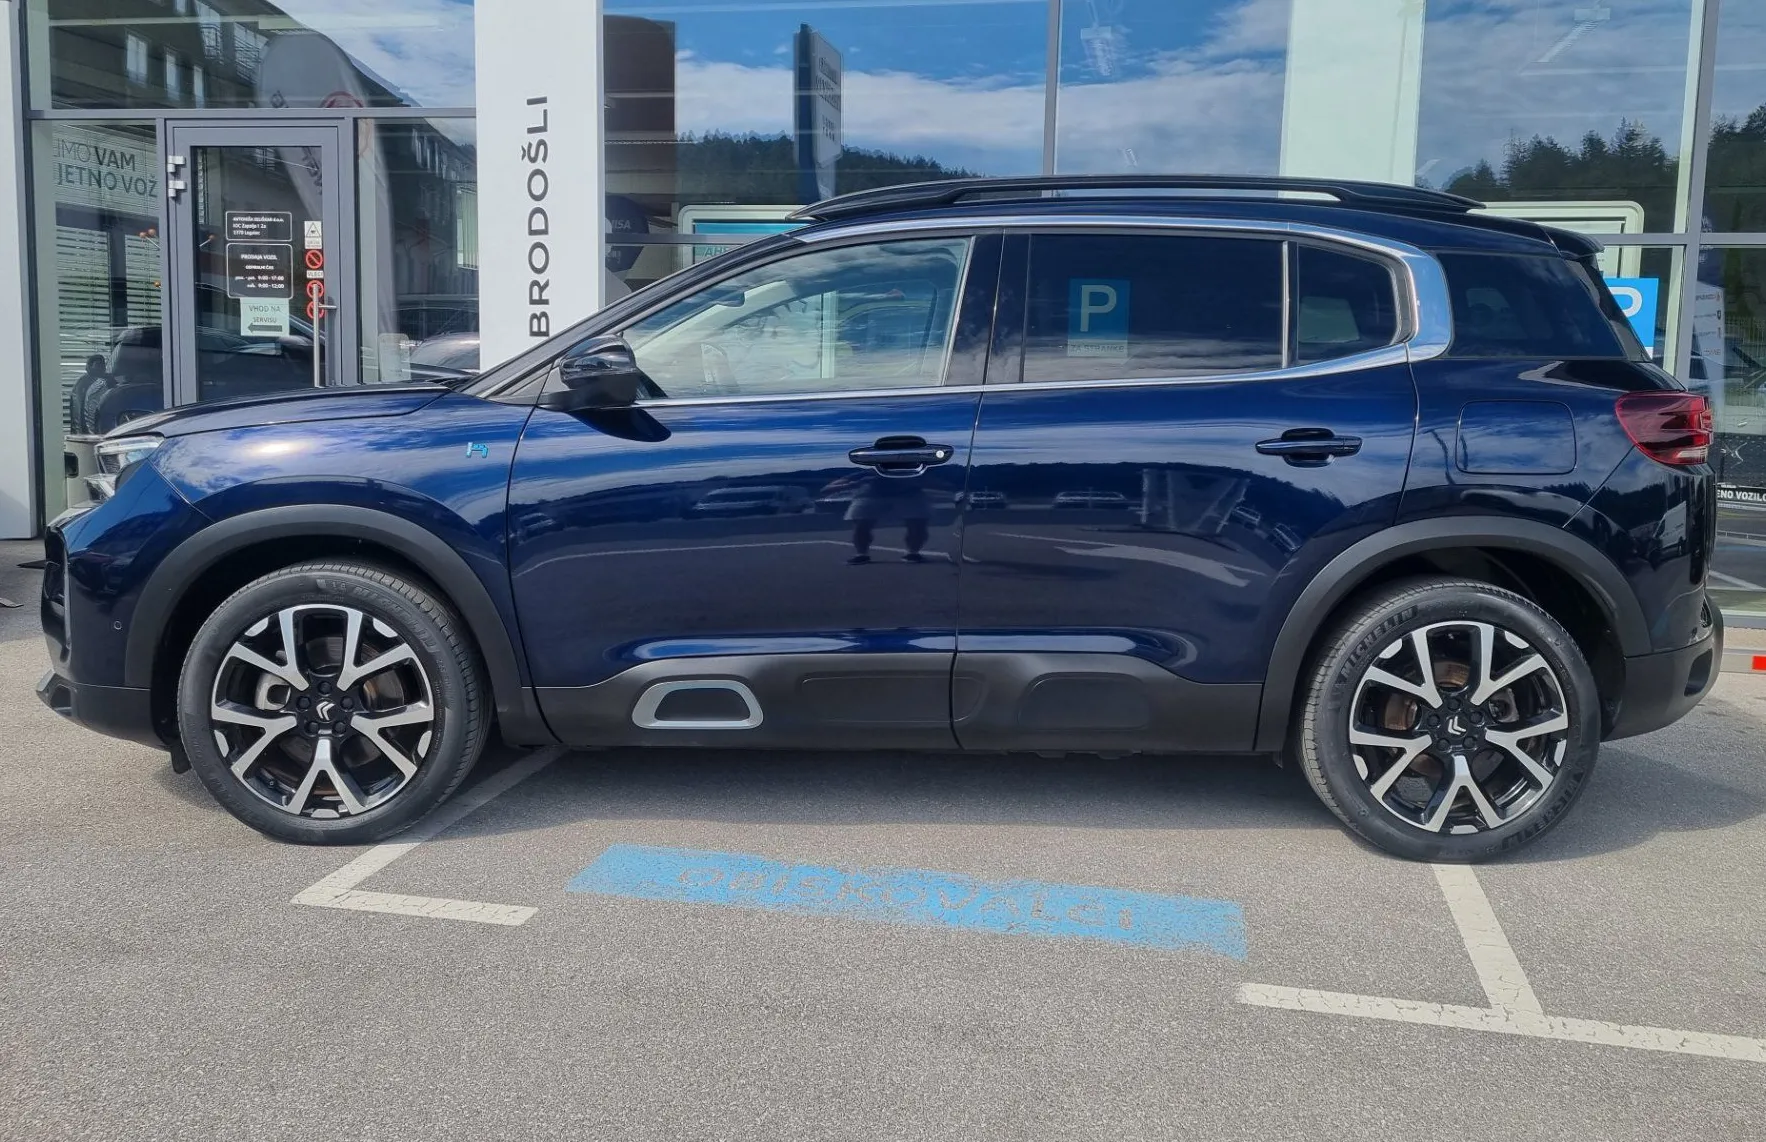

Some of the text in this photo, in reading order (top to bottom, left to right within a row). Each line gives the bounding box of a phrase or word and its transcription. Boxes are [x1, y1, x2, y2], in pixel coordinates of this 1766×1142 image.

[53, 138, 136, 172] IMO VAM
[521, 96, 550, 338] BRODOŠLI
[249, 305, 281, 313] VHOD NA
[1080, 284, 1117, 332] P
